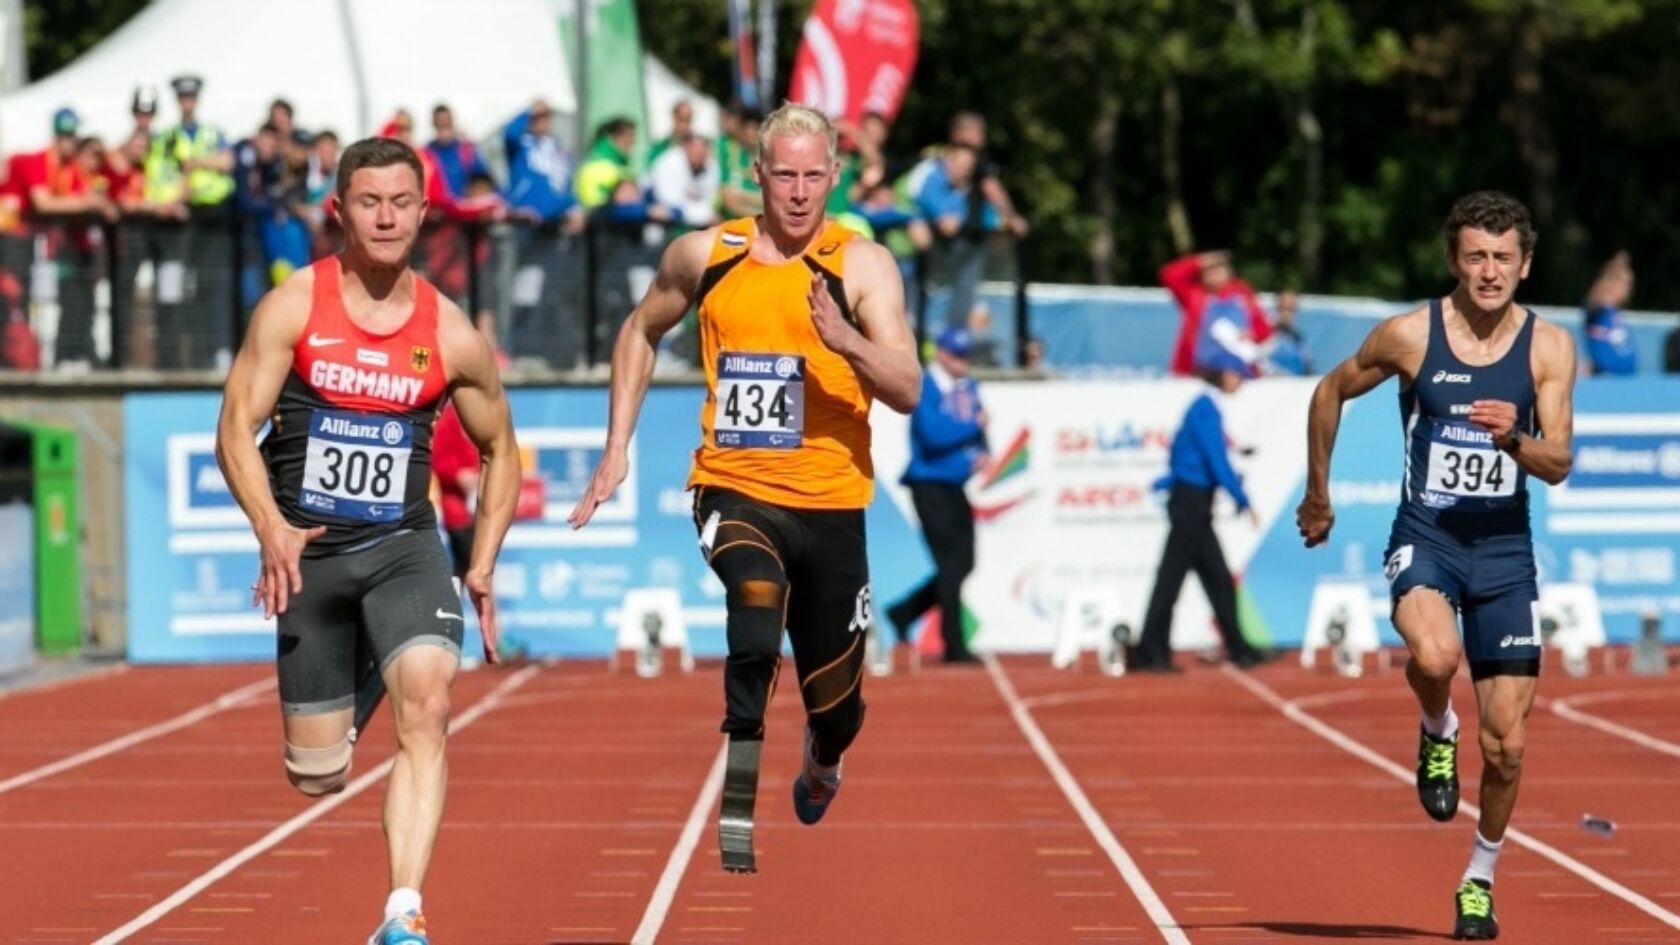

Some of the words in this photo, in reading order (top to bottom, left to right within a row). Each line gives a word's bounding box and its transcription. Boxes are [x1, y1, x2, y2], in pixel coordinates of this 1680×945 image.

[310, 359, 425, 406] GERMANY
[724, 357, 773, 373] Allianz
[724, 383, 789, 427] 434
[320, 417, 380, 439] Allianz
[1441, 425, 1493, 443] Allianz
[319, 447, 394, 497] 308
[1441, 451, 1503, 492] 394
